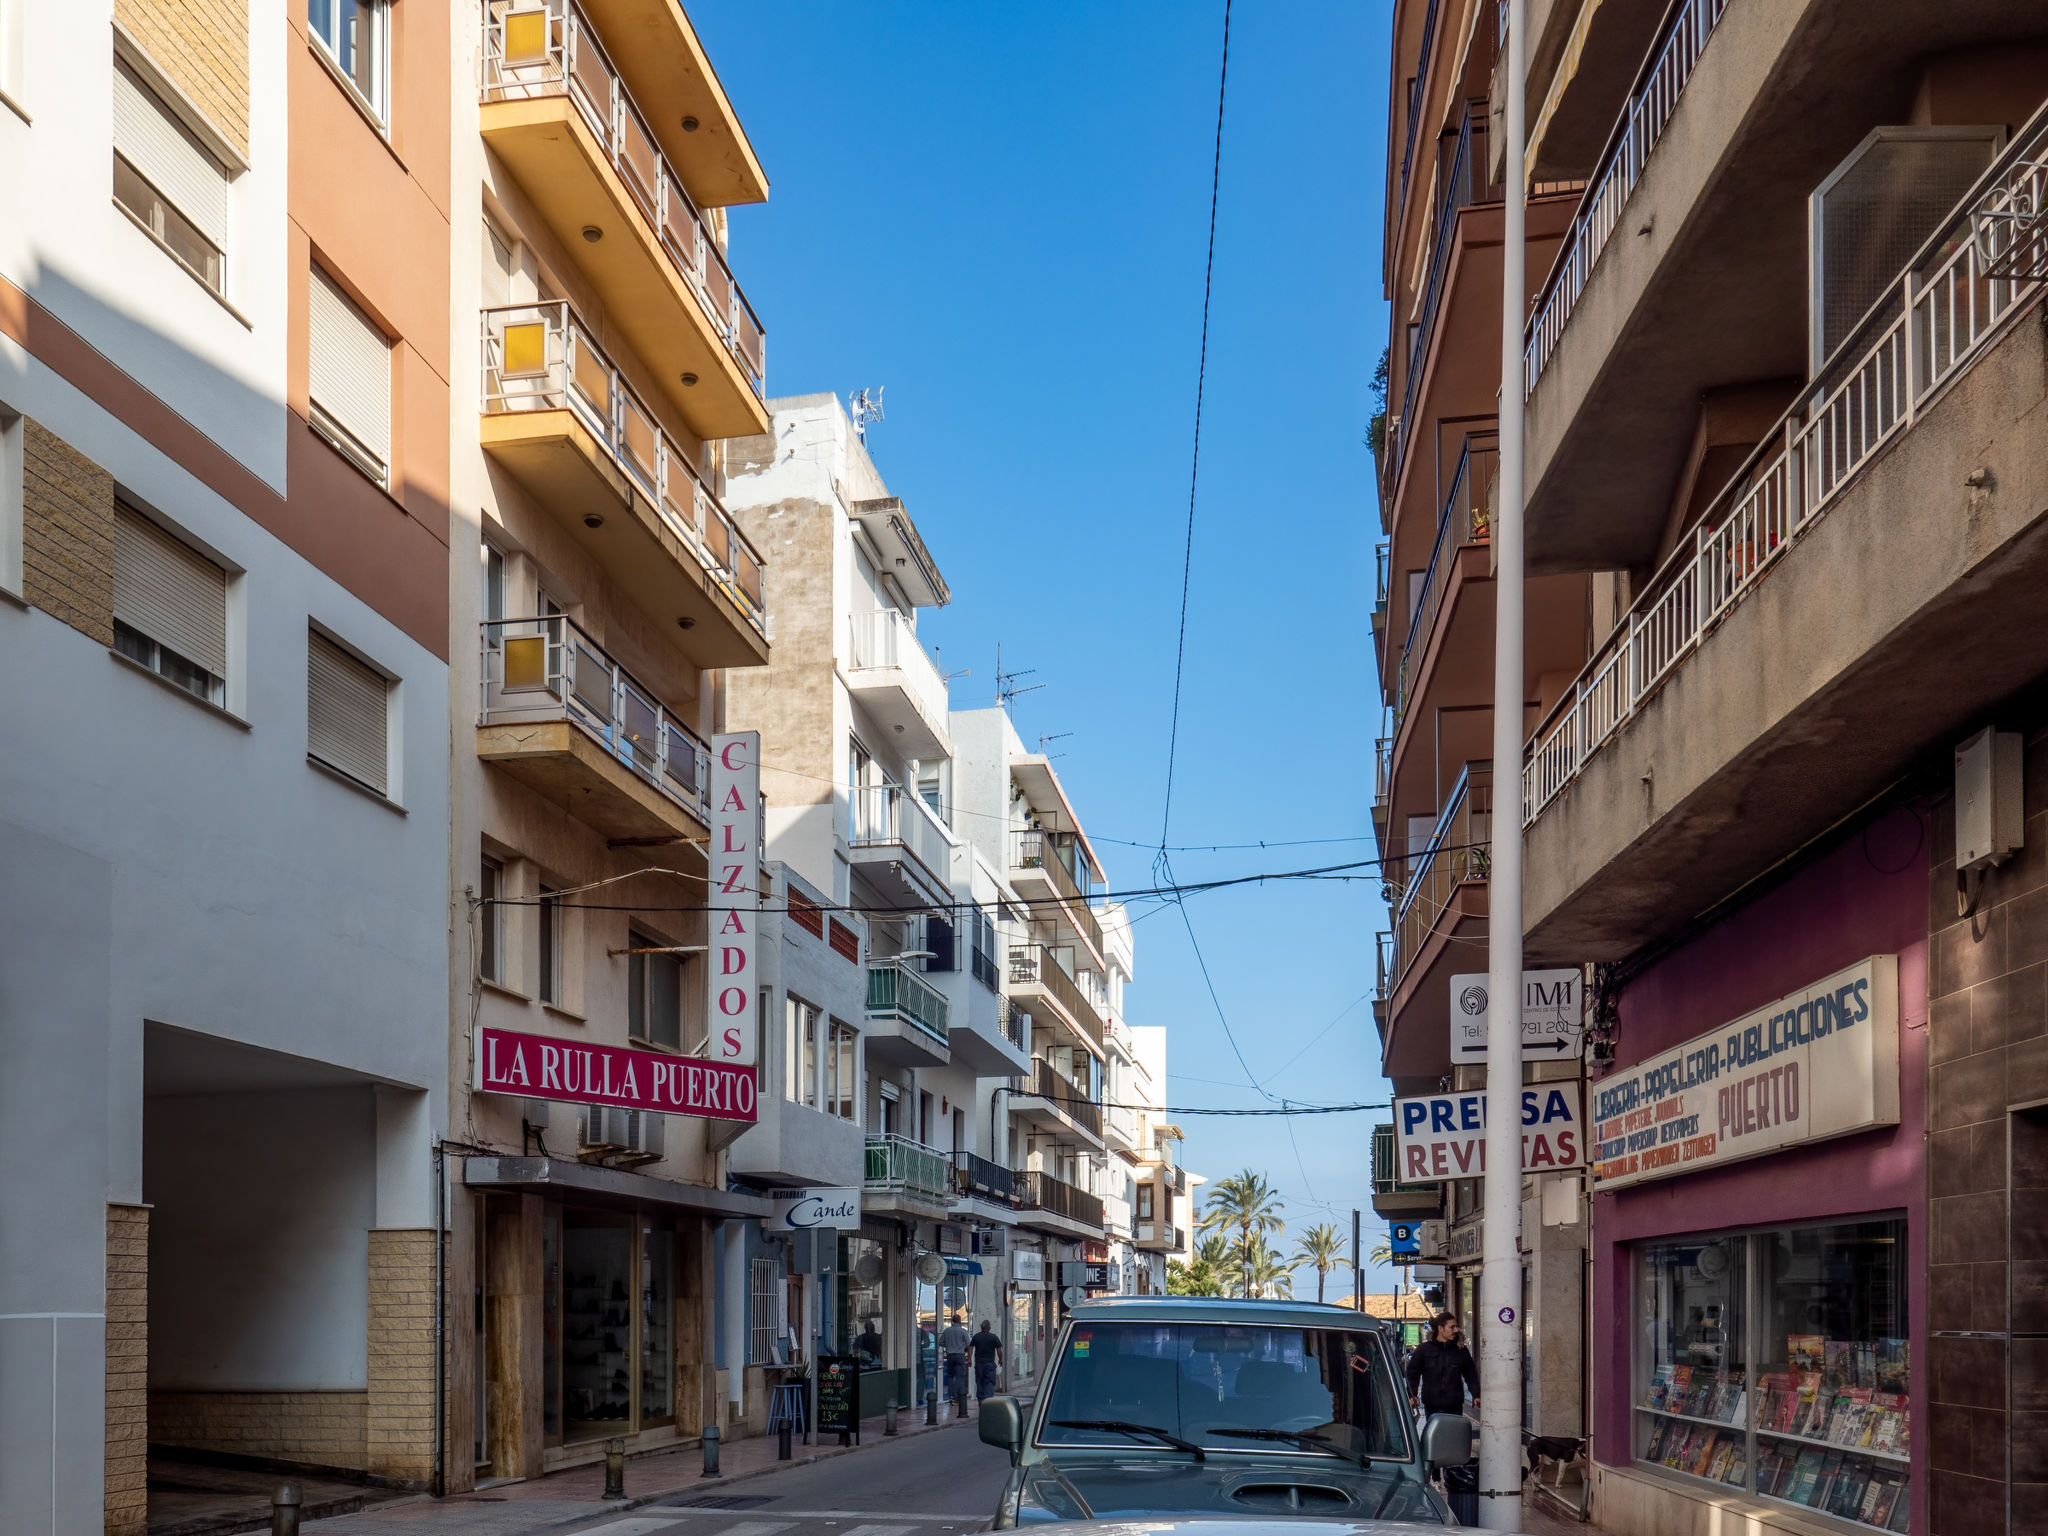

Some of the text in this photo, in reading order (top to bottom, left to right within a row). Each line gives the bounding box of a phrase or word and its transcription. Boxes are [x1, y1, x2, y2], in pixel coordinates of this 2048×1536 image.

[720, 741, 747, 1058] CALZADOS
[1462, 1025, 1483, 1038] Tel:
[1546, 1021, 1570, 1034] 201
[487, 1037, 755, 1114] LA RULLA PUERTO
[1403, 1090, 1573, 1136] PRESA
[1718, 1061, 1800, 1142] PUERTO
[772, 1190, 808, 1200] RESTAURANT
[785, 1197, 855, 1228] Cande
